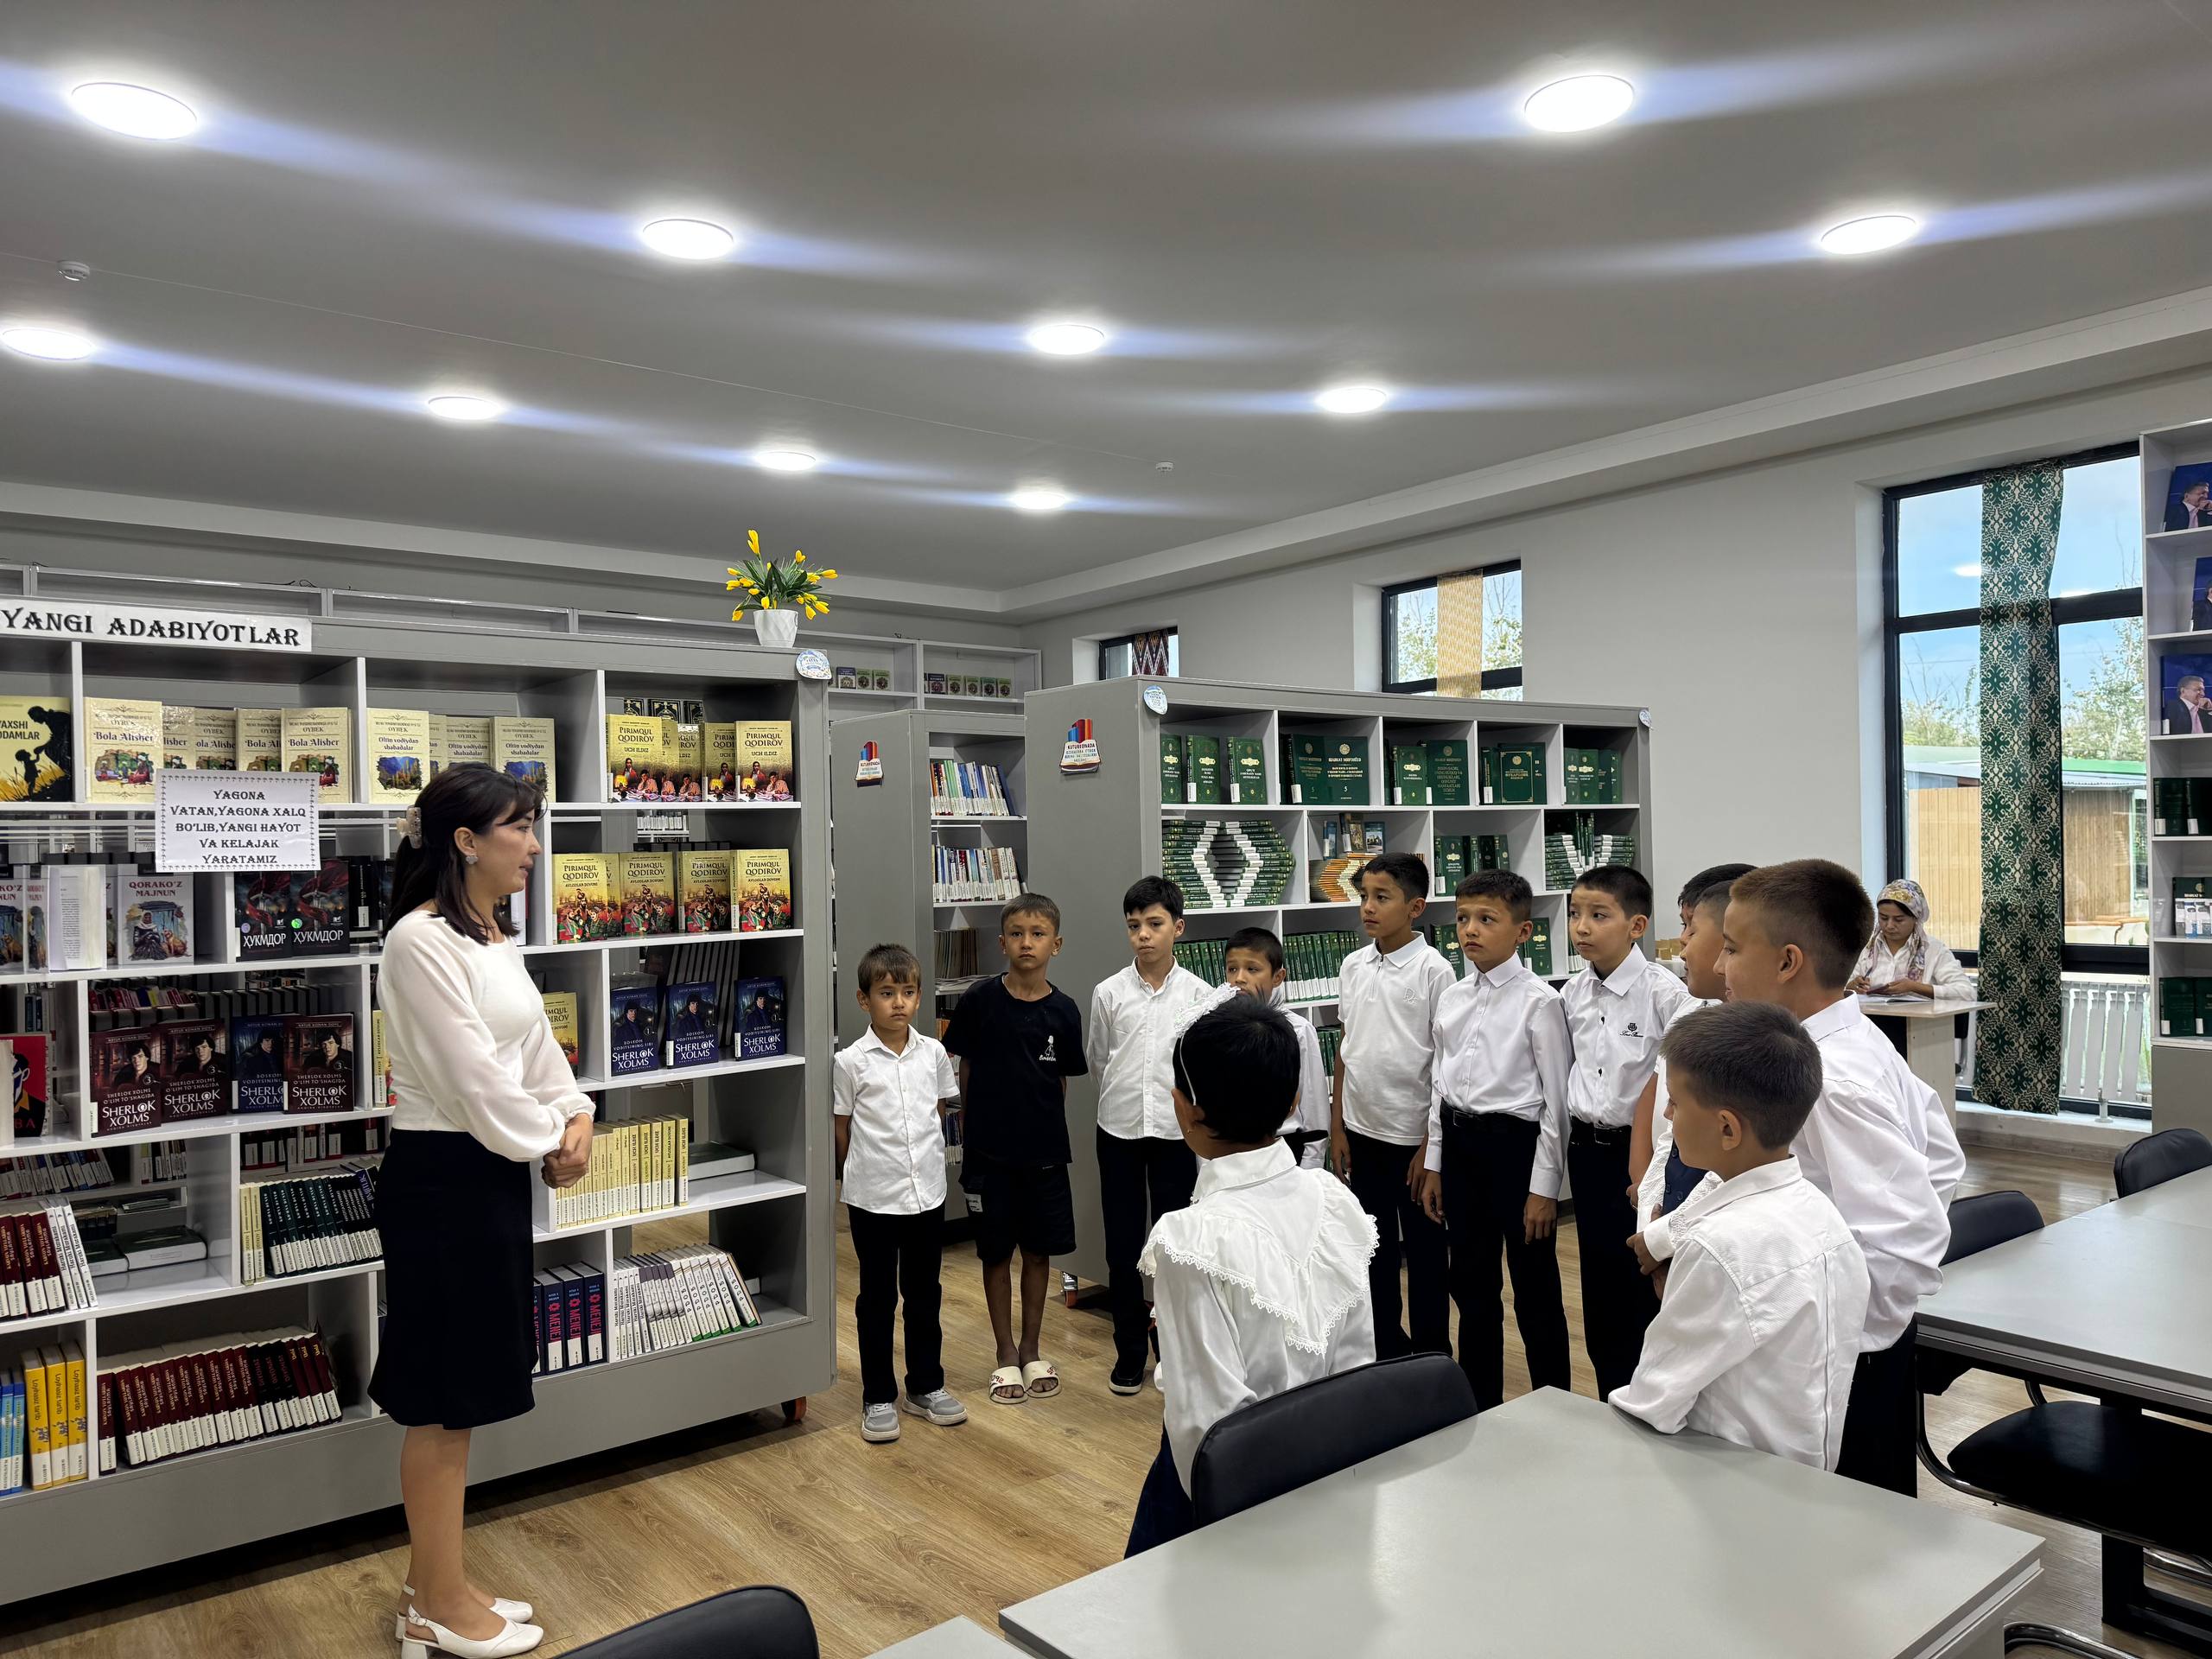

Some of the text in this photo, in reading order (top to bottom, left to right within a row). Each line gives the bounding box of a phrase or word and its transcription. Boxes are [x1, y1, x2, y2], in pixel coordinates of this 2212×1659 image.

[1, 607, 301, 647] YANGI ADABIYOTLAR
[93, 731, 118, 741] Bola
[620, 727, 652, 735] PIRIMQUL
[163, 737, 188, 746] lisher
[310, 738, 339, 747] Alisher
[213, 789, 265, 800] YAGONA
[170, 805, 306, 817] VATAN,YAGONA XALQ
[261, 823, 301, 833] HAYOT
[200, 838, 279, 849] VA KELAJAK
[202, 855, 277, 864] YARATAMIZ
[129, 880, 183, 889] QORAKO'Z
[676, 1039, 715, 1053] SHERLOK
[744, 1033, 781, 1047] SHERLOK
[749, 1042, 777, 1054] XOLMS
[612, 1048, 654, 1063] SHERLOK
[680, 1049, 710, 1060] XOLMS
[210, 1065, 215, 1074] 3
[618, 1058, 649, 1070] XOLMS
[146, 1076, 151, 1084] 3
[292, 1085, 346, 1097] SHERLOK
[164, 1089, 221, 1106] SHERLOK
[300, 1096, 340, 1106] XOLMS
[102, 1100, 156, 1118] SHERLOK
[172, 1101, 214, 1114] XOLMS
[110, 1112, 149, 1127] XOLMS
[53, 1225, 67, 1271] Haruki Murakami
[60, 1224, 76, 1268] Haruki Murakami
[70, 1224, 86, 1268] Haruki Murakami
